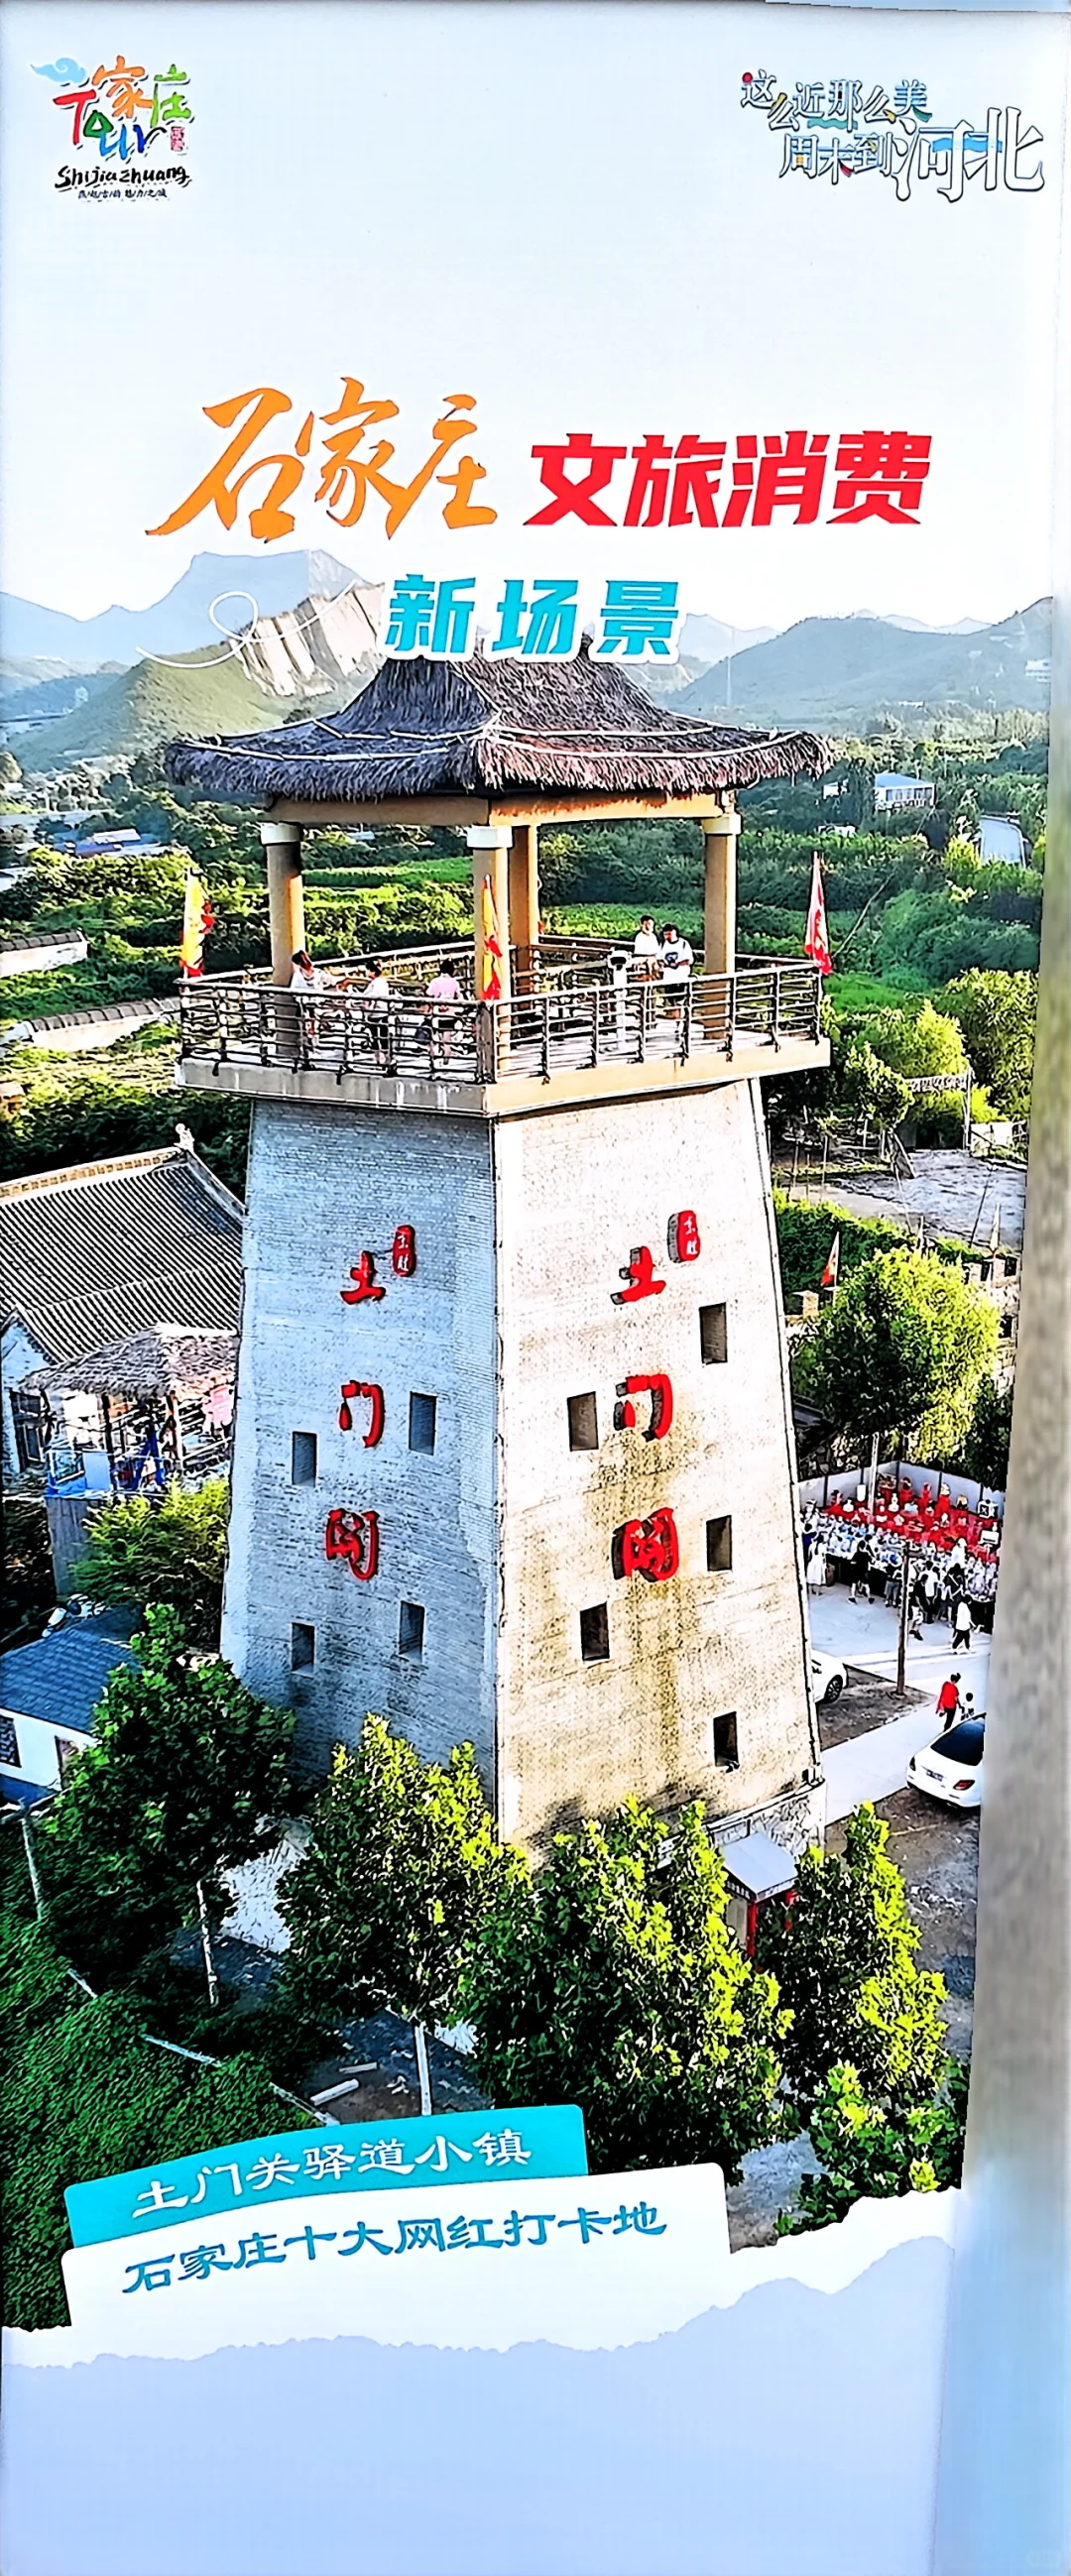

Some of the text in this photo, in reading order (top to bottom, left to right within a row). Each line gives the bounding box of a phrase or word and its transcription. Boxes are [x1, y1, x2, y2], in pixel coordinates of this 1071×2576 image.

[740, 68, 931, 132] 这么近那么美
[778, 106, 1045, 203] 周末到河北
[146, 376, 933, 543] 石家庄 文旅消费
[385, 572, 681, 657] 新场景
[131, 2127, 533, 2220] 土门关驿道小镇
[122, 2200, 668, 2295] 石家庄十大网红打卡地
